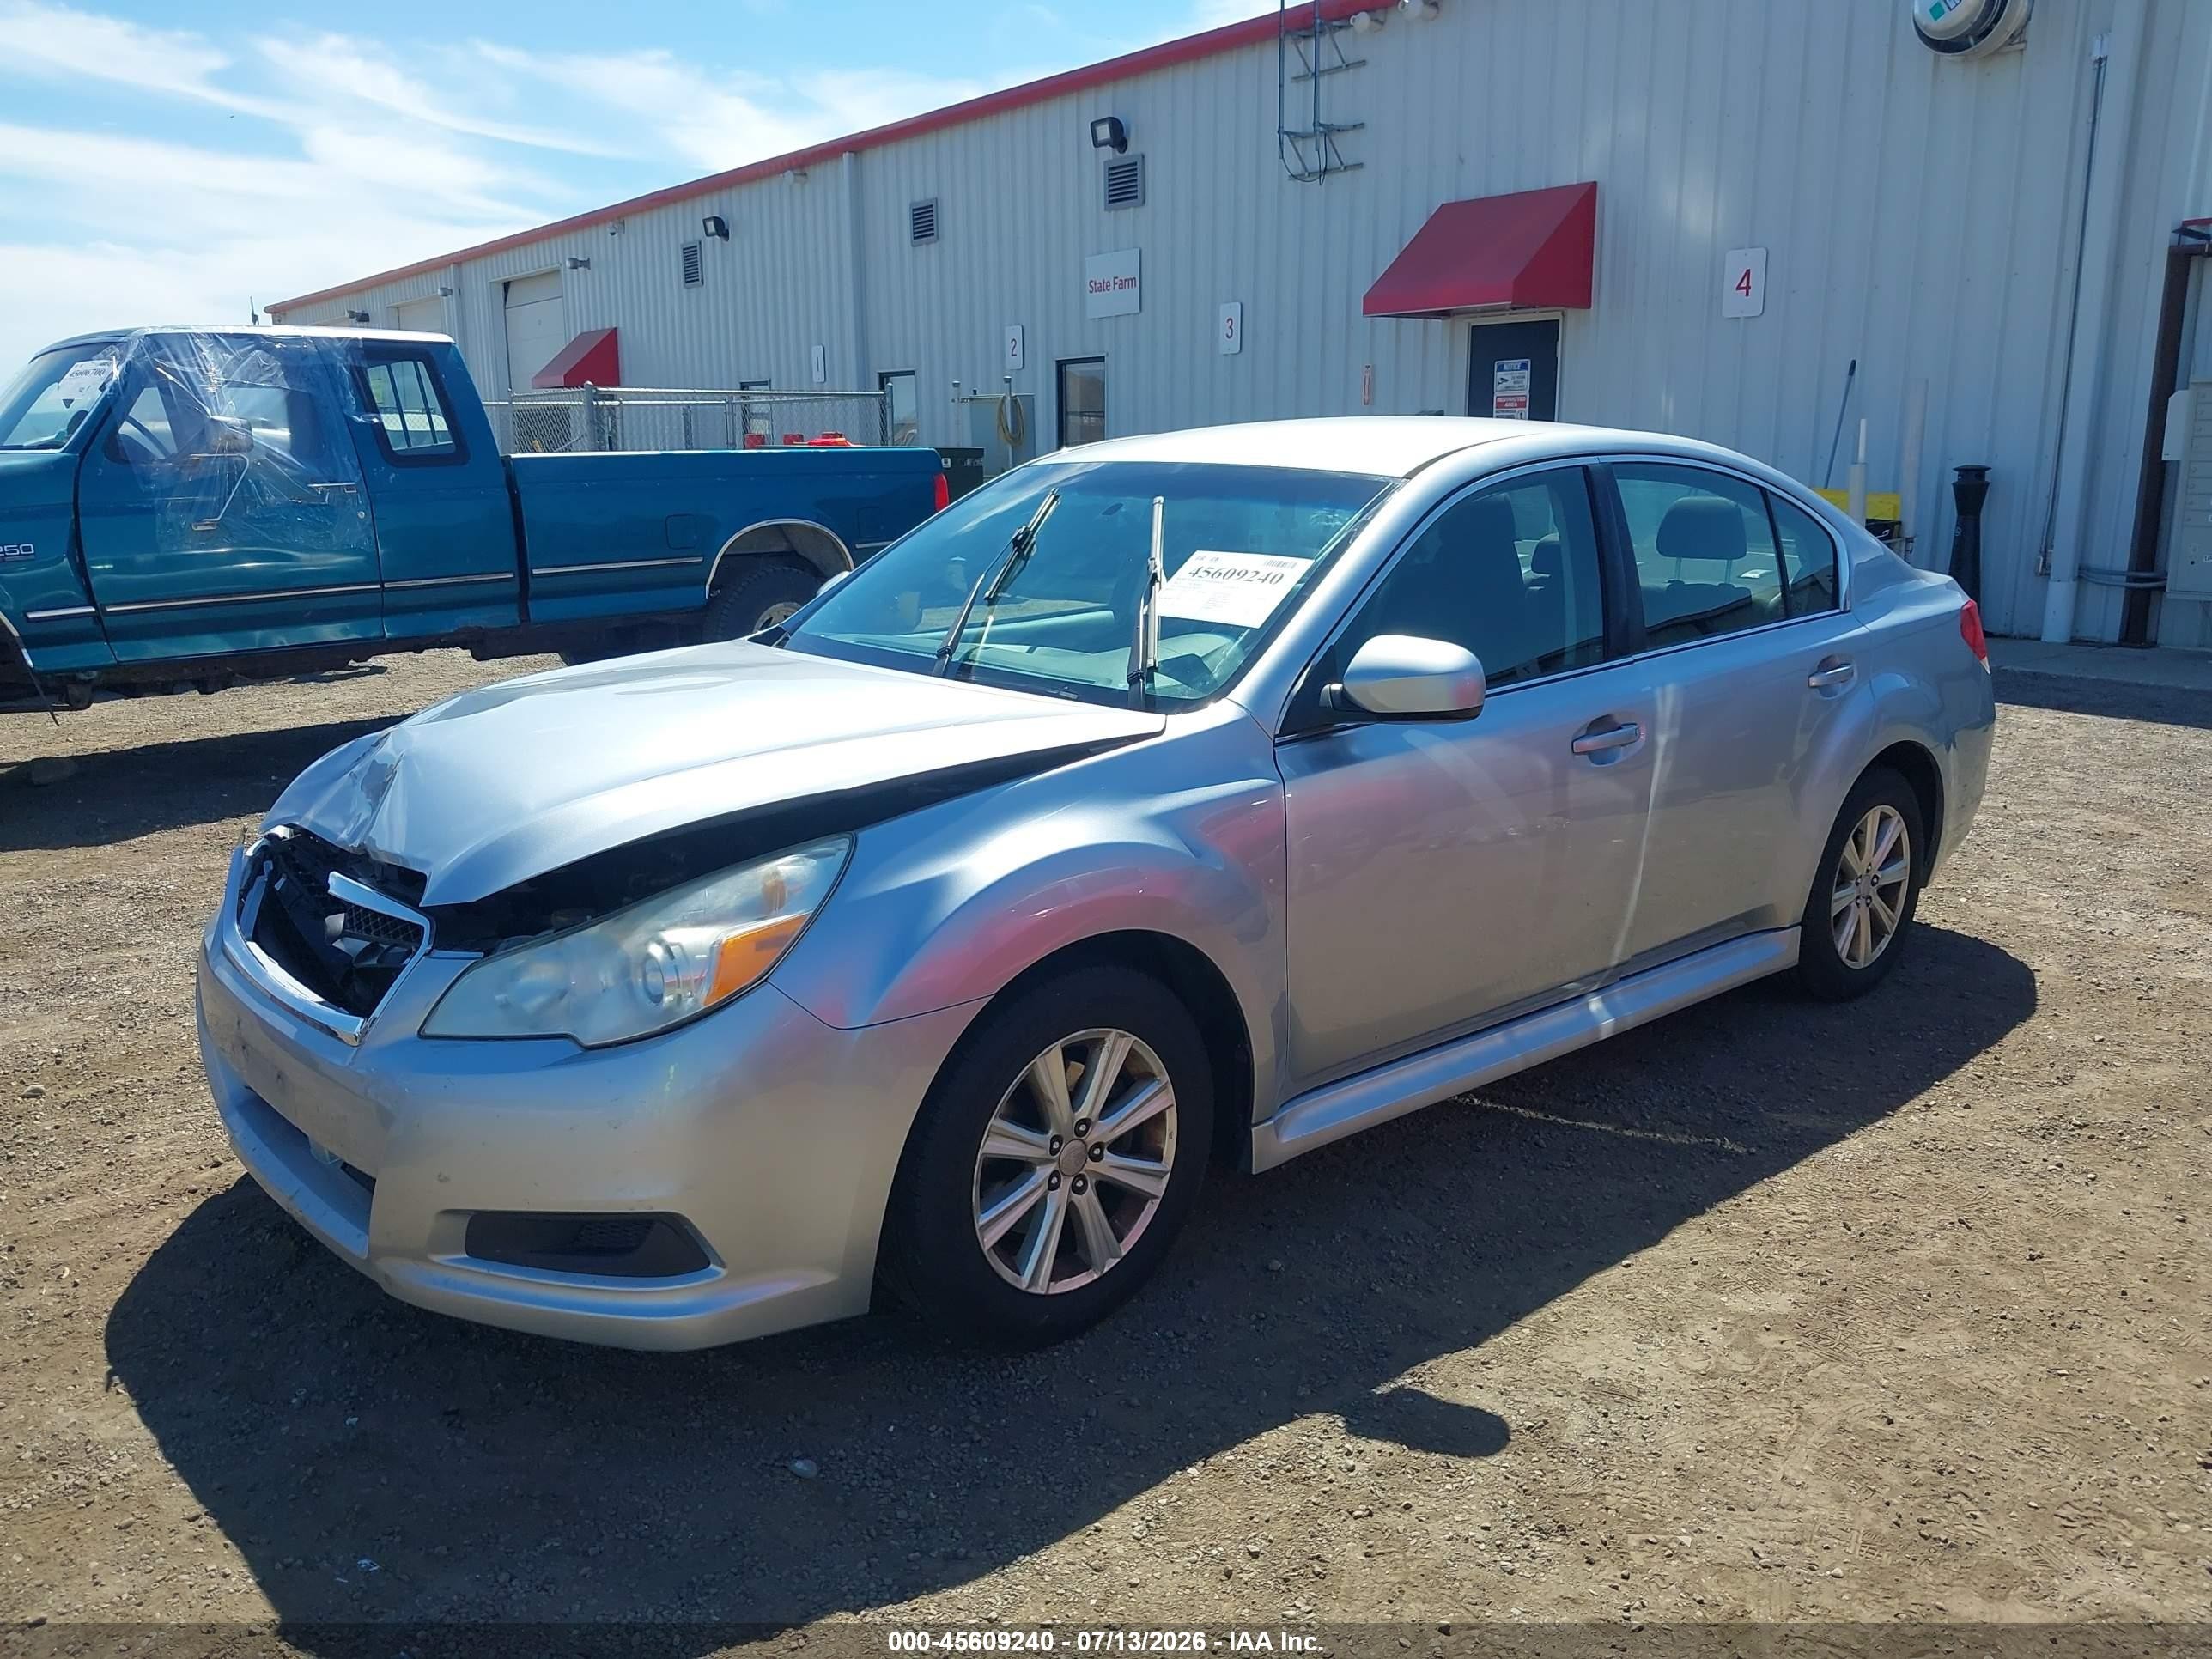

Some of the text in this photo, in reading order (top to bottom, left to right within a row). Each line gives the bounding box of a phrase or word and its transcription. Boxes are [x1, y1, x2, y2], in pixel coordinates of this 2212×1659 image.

[1089, 276, 1137, 294] State Farm
[1735, 268, 1752, 297] 4
[1225, 317, 1233, 339] 3
[1010, 337, 1018, 357] 2
[1188, 566, 1285, 586] 45609240
